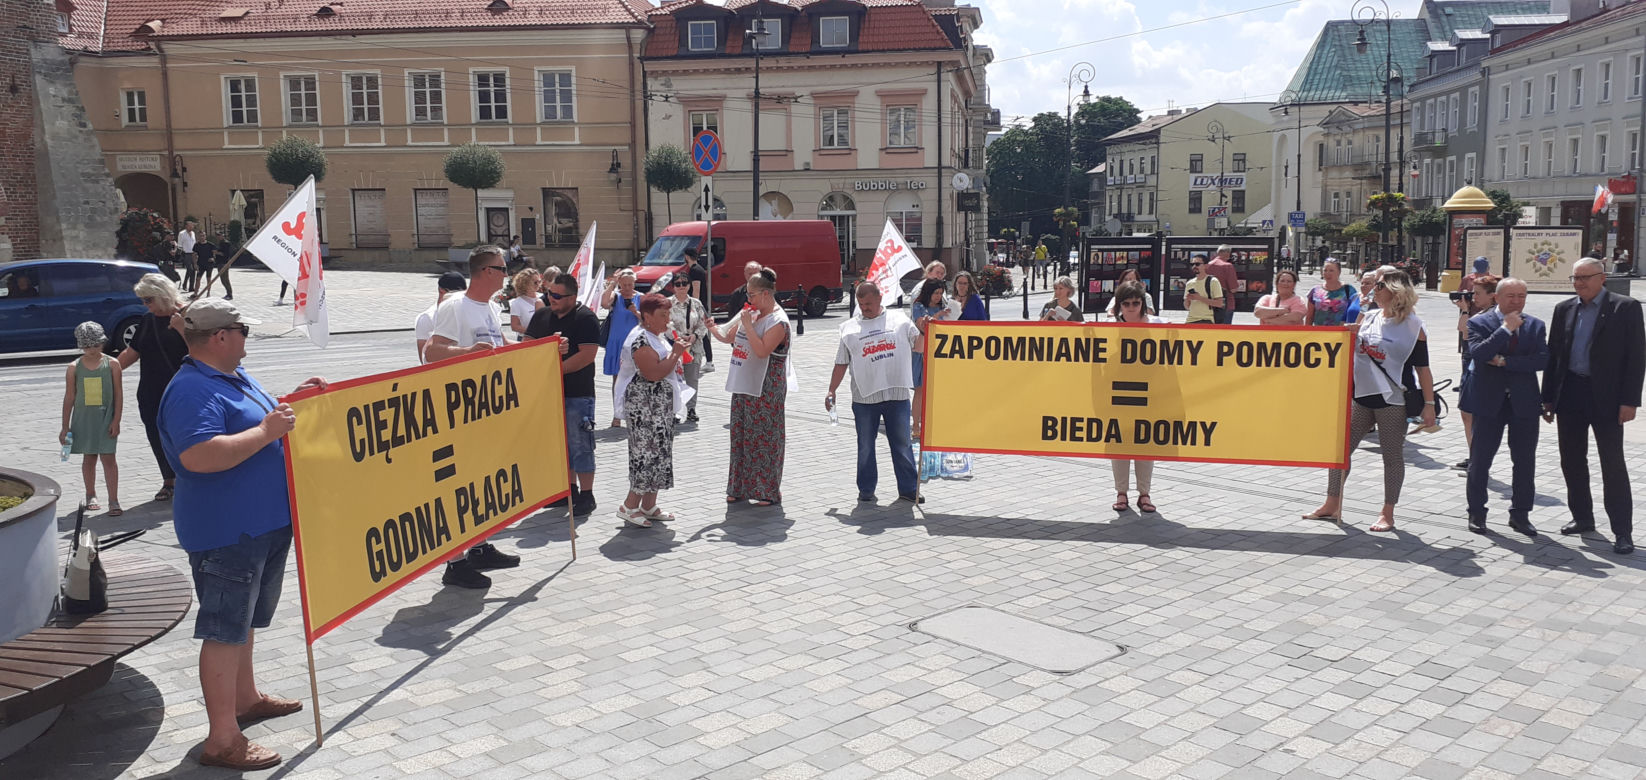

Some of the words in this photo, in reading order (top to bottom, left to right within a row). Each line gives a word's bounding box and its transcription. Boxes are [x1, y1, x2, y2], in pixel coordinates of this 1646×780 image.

[855, 180, 897, 191] Bubble
[906, 180, 926, 190] Tea
[271, 235, 298, 258] REGION
[871, 352, 894, 362] LUBLIN
[934, 334, 1107, 363] ZAPOMNIANE
[1121, 339, 1204, 365] DOMY
[1217, 341, 1343, 369] POMOCY
[445, 367, 520, 430] PRACA
[1042, 416, 1123, 443] BIEDA
[1134, 420, 1218, 446] DOMY
[365, 497, 452, 584] GODNA
[455, 463, 525, 535] PŁACA
